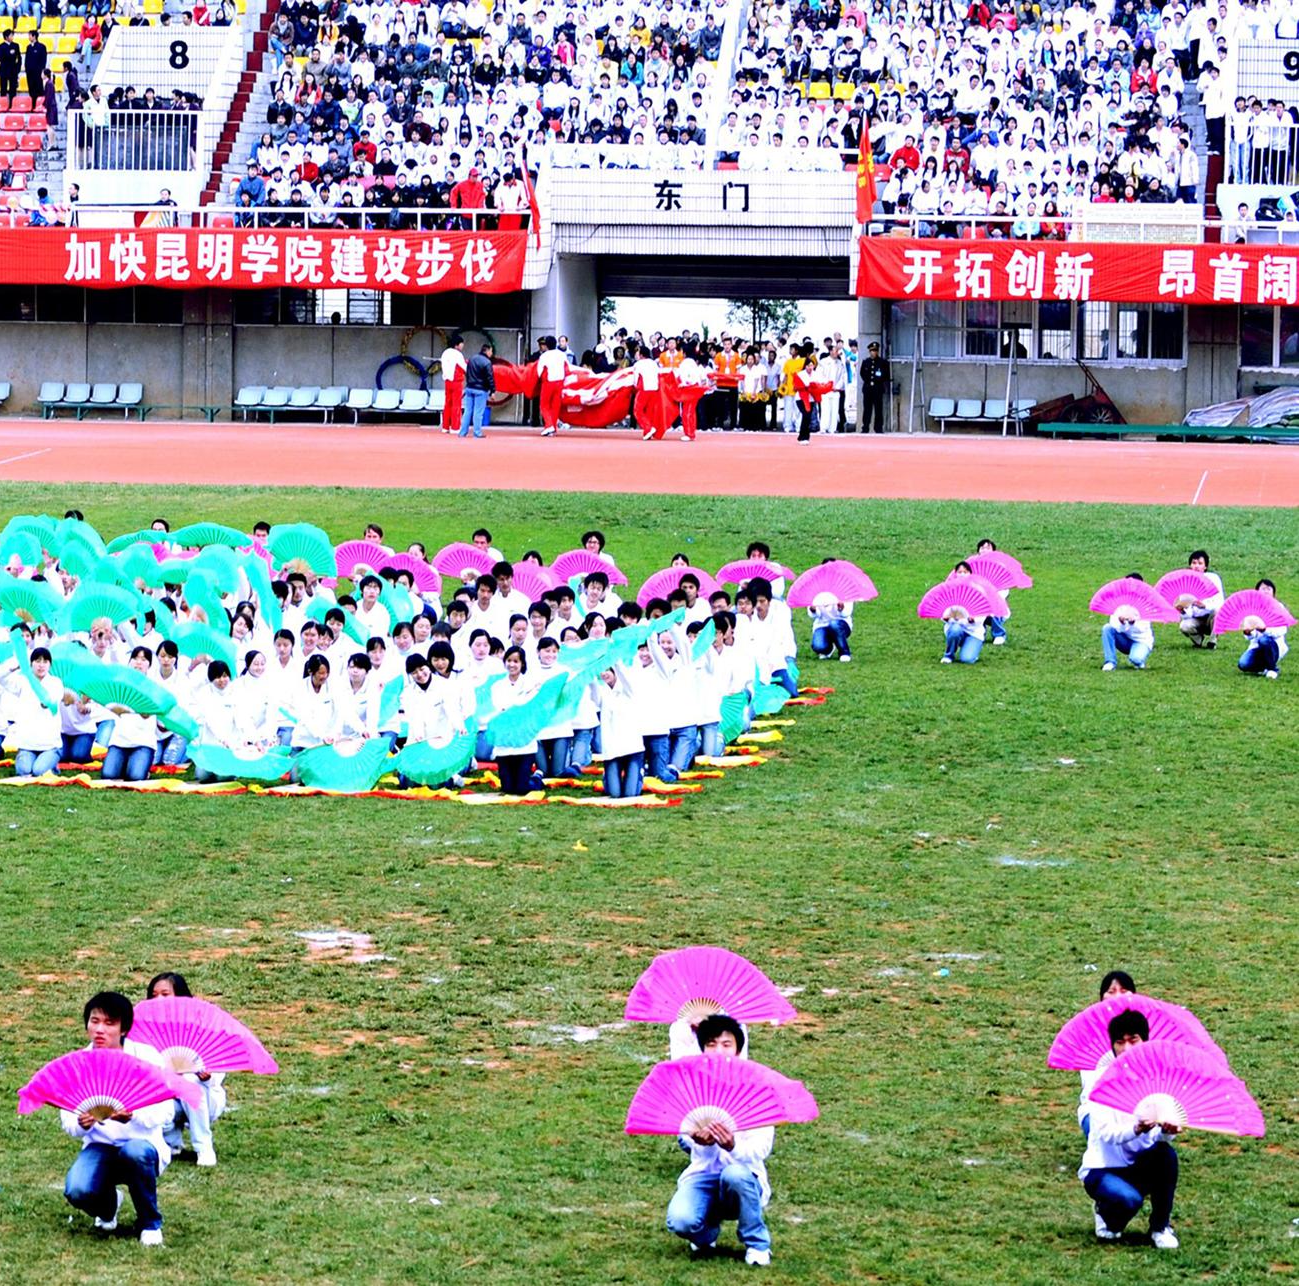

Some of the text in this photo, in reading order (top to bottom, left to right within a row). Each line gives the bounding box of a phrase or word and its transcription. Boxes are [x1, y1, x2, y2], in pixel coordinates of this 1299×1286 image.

[168, 40, 190, 69] 8
[1283, 51, 1299, 82] 9
[64, 232, 498, 286] 加快昆明学院建设步伐
[903, 249, 1297, 304] 开拓创新 昂首阔
